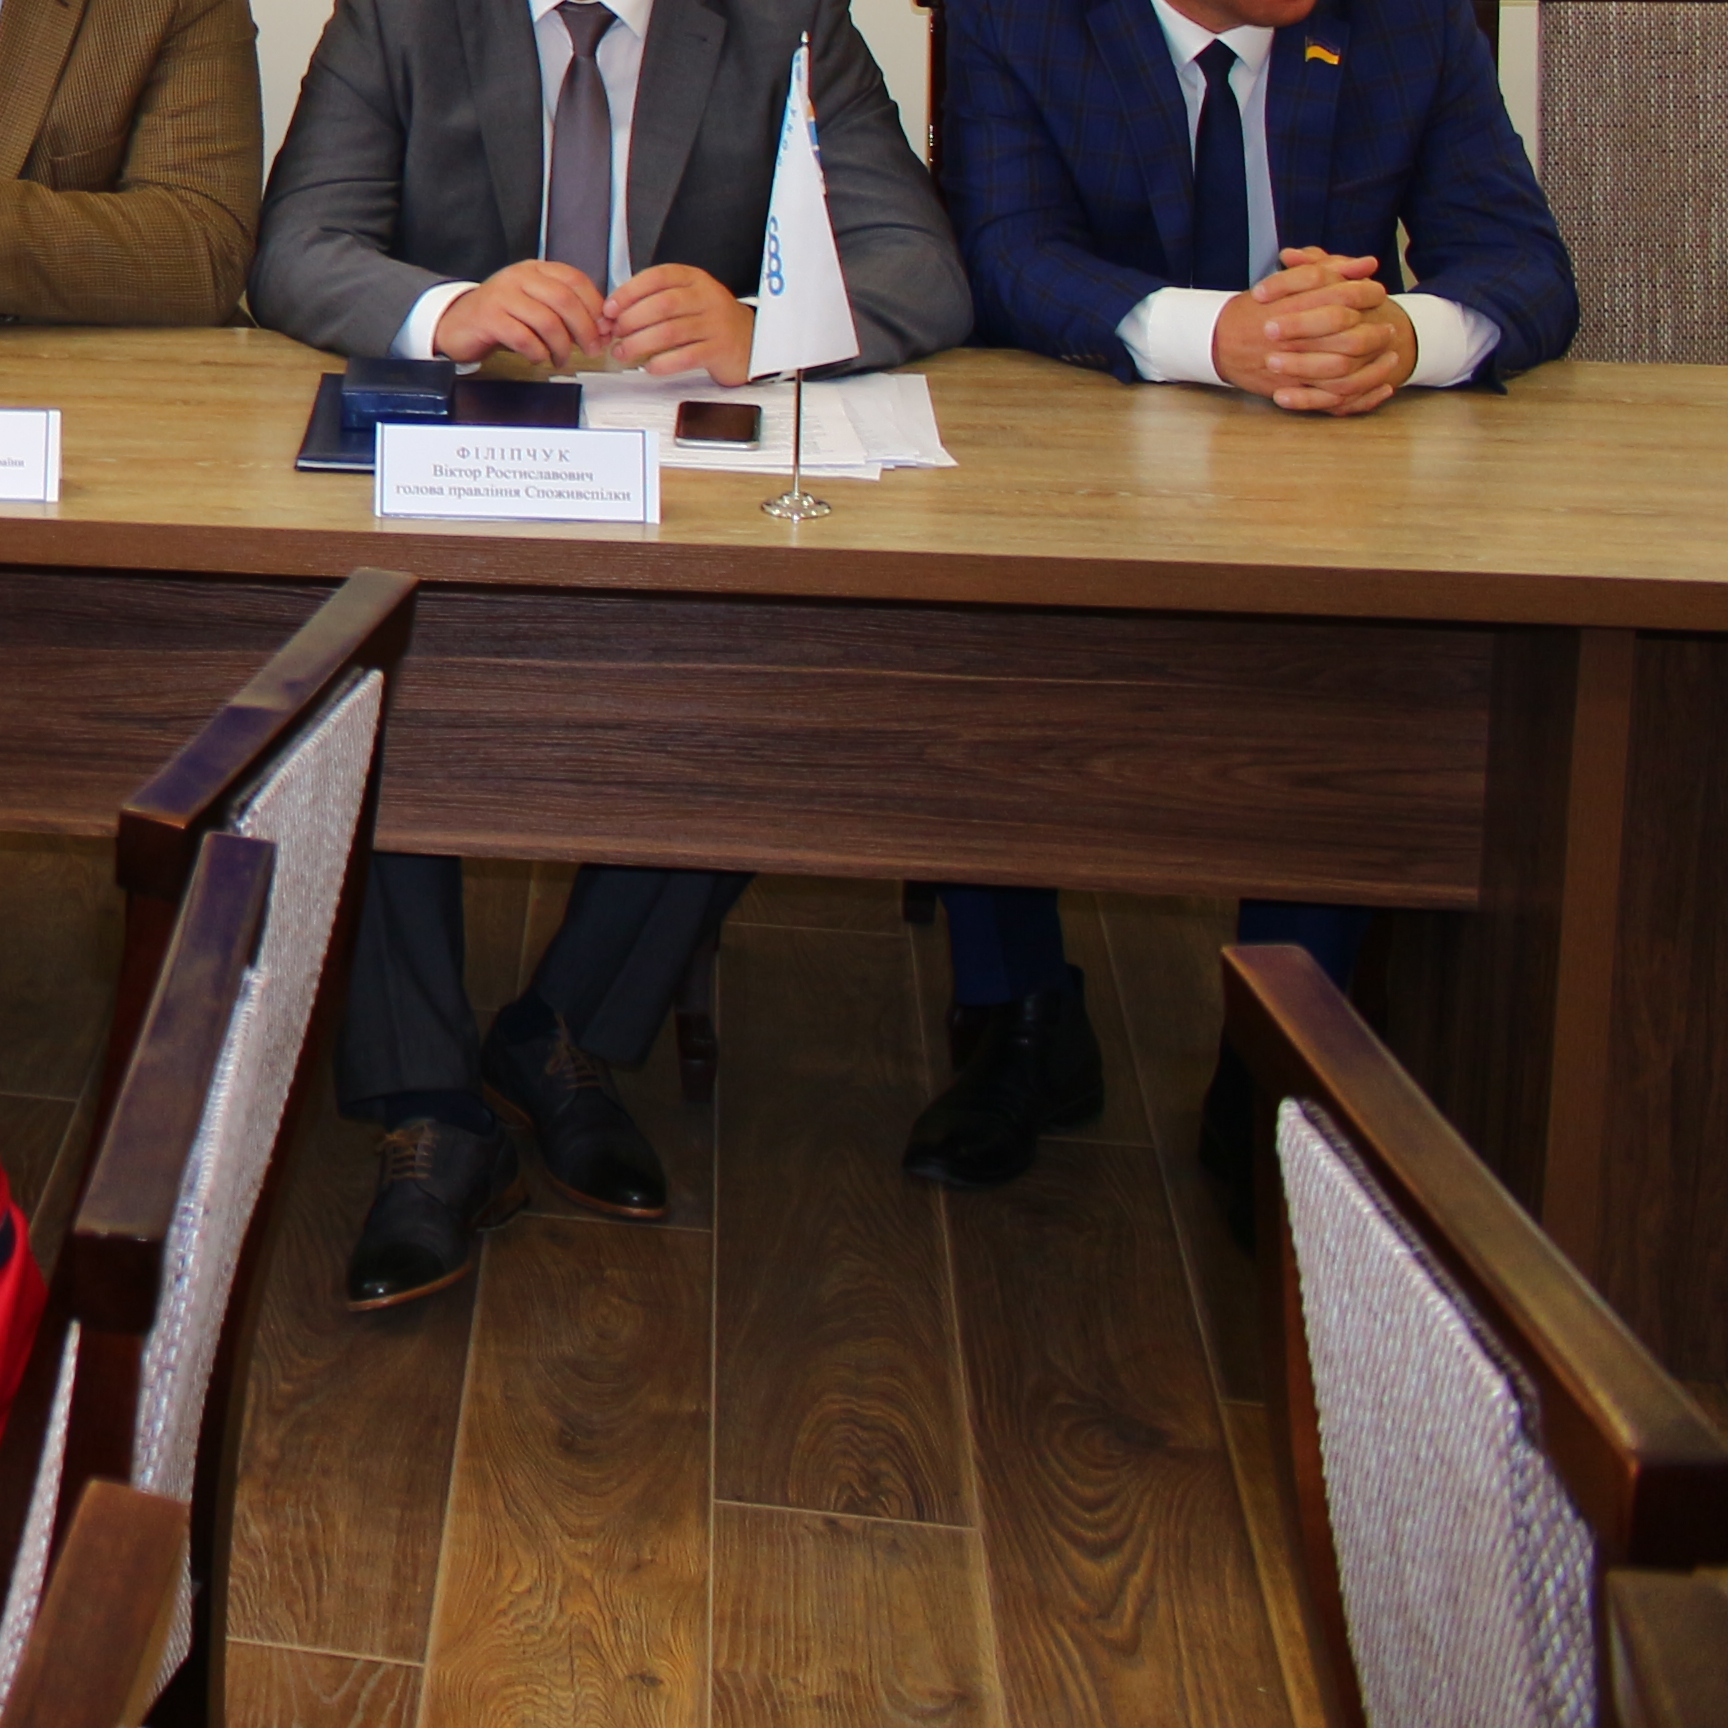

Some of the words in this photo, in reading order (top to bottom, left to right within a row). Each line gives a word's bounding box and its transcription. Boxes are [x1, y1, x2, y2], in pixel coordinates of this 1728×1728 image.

[456, 446, 571, 463] ФІЛІПЧУК
[432, 464, 482, 480] Віктор
[485, 465, 594, 482] Ростиславович
[395, 483, 444, 496] голова
[448, 484, 520, 499] правління
[525, 486, 631, 502] Споживспілки
